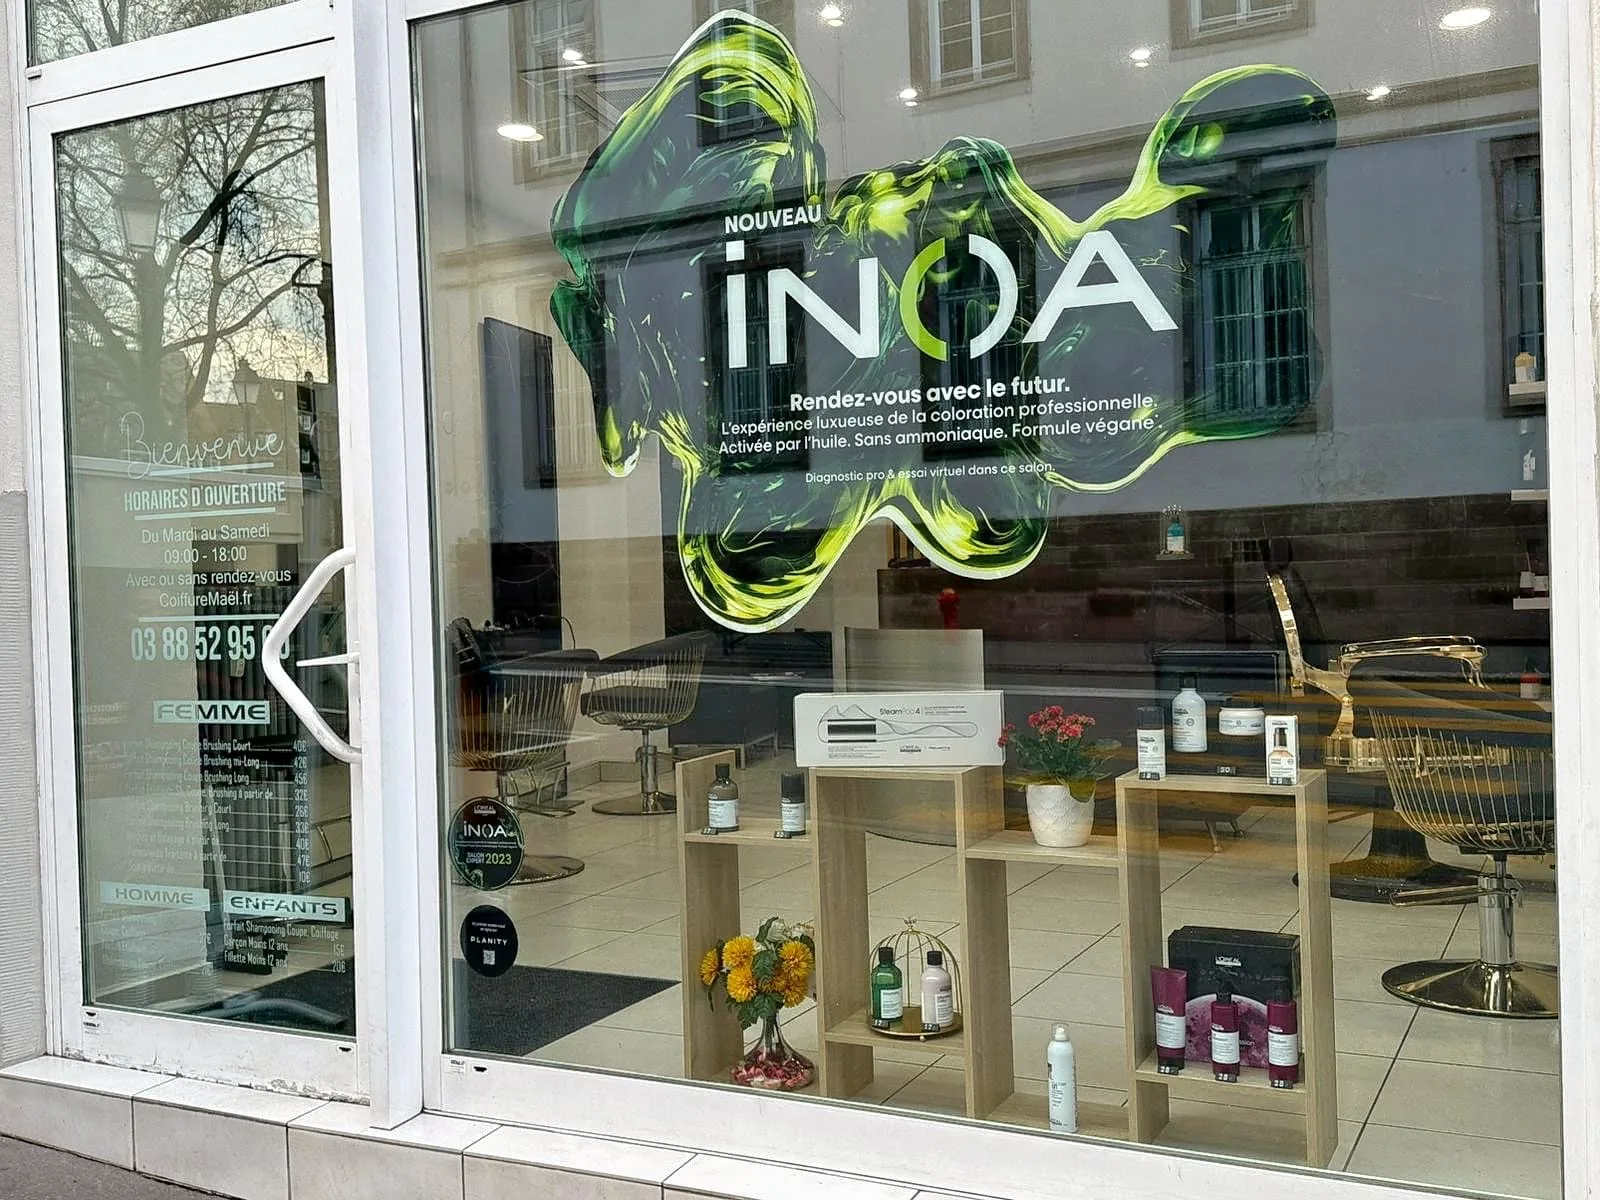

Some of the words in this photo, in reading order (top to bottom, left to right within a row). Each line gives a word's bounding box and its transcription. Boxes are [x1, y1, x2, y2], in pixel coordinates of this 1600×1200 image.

[724, 204, 822, 233] NOUVEAU
[790, 388, 921, 412] Rendez-vous
[926, 384, 981, 402] avec
[986, 378, 1006, 398] le
[1011, 376, 1071, 396] futur.
[721, 417, 813, 437] L'expérience
[816, 413, 884, 430] luxueuse
[887, 410, 908, 425] de
[912, 409, 927, 424] la
[930, 403, 1014, 422] coloration
[1018, 393, 1158, 419] professionnelle.
[120, 411, 284, 480] Bienvenue
[719, 438, 772, 455] Activée
[776, 439, 801, 455] par
[804, 434, 851, 450] l'huile.
[854, 433, 892, 448] Sans
[895, 426, 1008, 445] ammoniaque.
[1012, 420, 1081, 437] Formule
[805, 469, 863, 485] Diagnostic
[866, 471, 885, 483] pro
[887, 470, 894, 480] &
[897, 468, 927, 479] essai
[929, 465, 966, 478] virtuel
[968, 463, 998, 476] dans
[1000, 464, 1016, 475] ce
[1018, 461, 1055, 473] salon.
[124, 487, 188, 512] HORAIRES
[191, 481, 287, 507] D'OUVERTURE
[142, 529, 159, 544] Du
[163, 527, 197, 543] Mardi
[201, 530, 217, 541] au
[220, 523, 270, 540] Samedi
[164, 548, 199, 564] 09:00
[212, 546, 247, 562] 18:00
[126, 573, 158, 587] Avec
[159, 574, 174, 586] ou
[177, 572, 208, 585] sans
[211, 569, 292, 584] rendez-vous
[159, 590, 253, 608] CoiffureMaël.fr
[131, 626, 156, 661] 03
[162, 626, 189, 661] 88
[195, 625, 221, 661] 52
[227, 625, 256, 661] 95
[158, 703, 267, 720] FEMME
[203, 739, 232, 753] Brushing
[233, 739, 251, 751] Court
[203, 754, 232, 769] Brushing
[204, 770, 233, 785] Brushing
[233, 771, 250, 785] Long
[244, 788, 263, 800] partir
[265, 788, 273, 800] de
[213, 802, 232, 814] Court
[485, 853, 512, 865] 2023
[114, 887, 194, 904] HOMME
[230, 895, 338, 916] ENFANTS
[268, 938, 275, 950] 12
[276, 942, 288, 951] ans
[224, 951, 246, 964] Fillette
[267, 954, 274, 966] 12
[276, 958, 288, 969] ans
